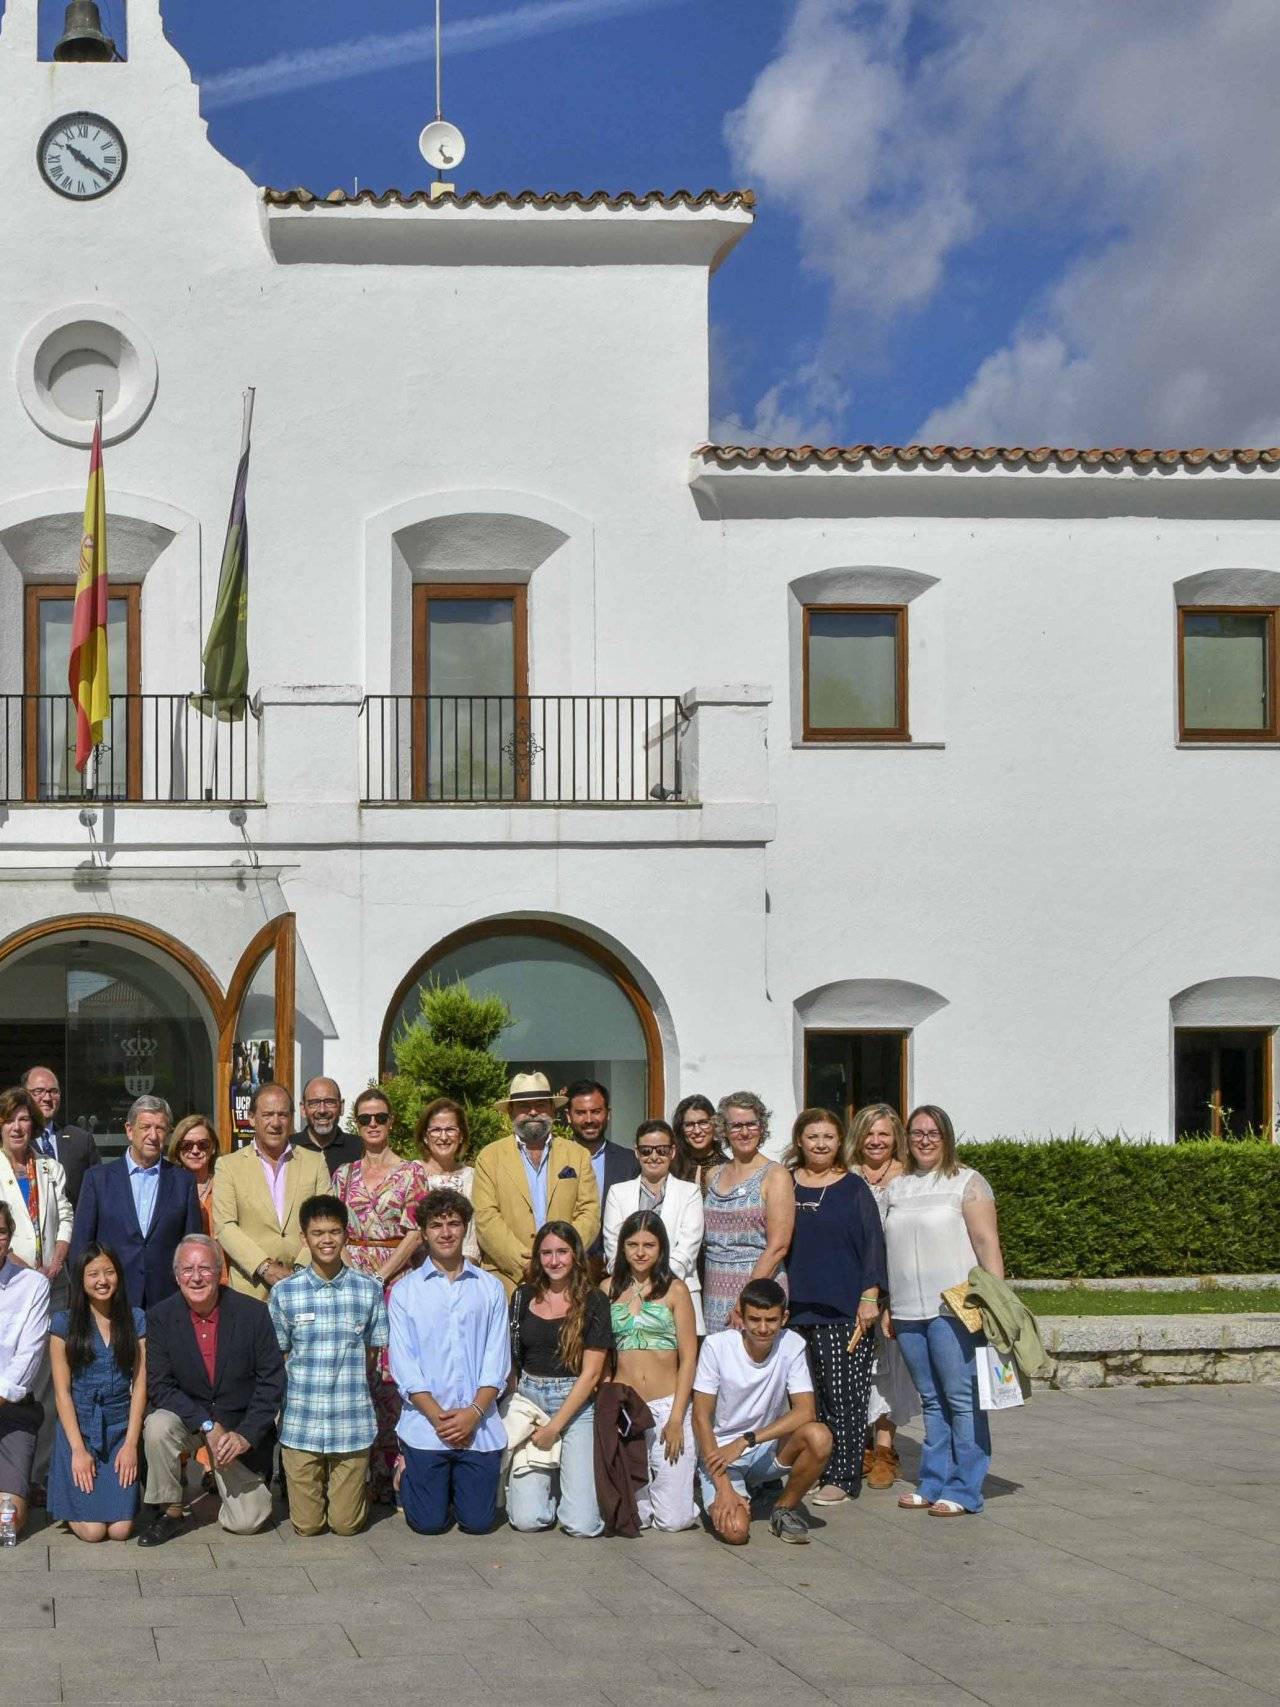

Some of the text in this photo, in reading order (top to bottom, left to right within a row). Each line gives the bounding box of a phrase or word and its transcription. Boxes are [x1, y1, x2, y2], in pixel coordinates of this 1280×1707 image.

[63, 128, 75, 140] XI
[77, 124, 88, 138] XII
[101, 141, 113, 150] II
[104, 156, 116, 164] III
[77, 180, 86, 193] VI
